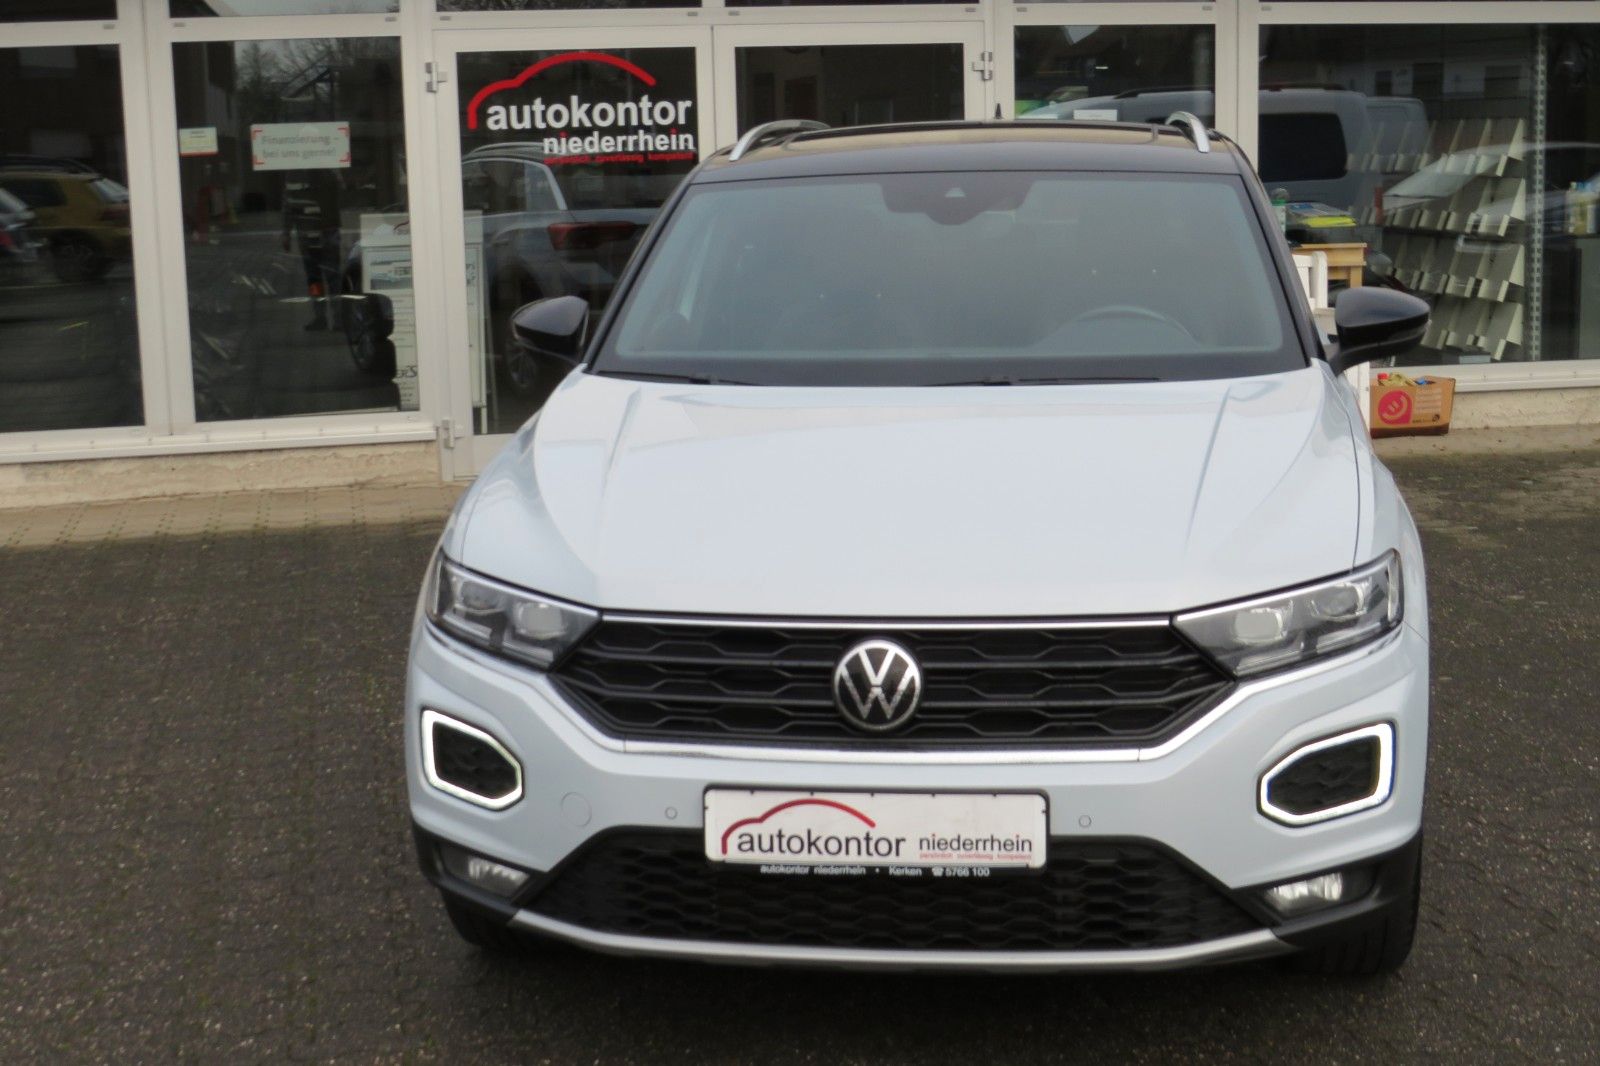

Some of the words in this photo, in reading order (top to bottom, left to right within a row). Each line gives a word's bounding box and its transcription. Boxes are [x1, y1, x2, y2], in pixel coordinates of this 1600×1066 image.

[486, 95, 692, 130] autokontor
[543, 129, 696, 155] niederrhein
[737, 828, 906, 857] autokontor
[919, 833, 1033, 852] niederrhein
[760, 864, 810, 874] autokontor
[813, 864, 866, 875] niederrhein
[889, 866, 922, 877] Kerken
[972, 867, 990, 877] 100
